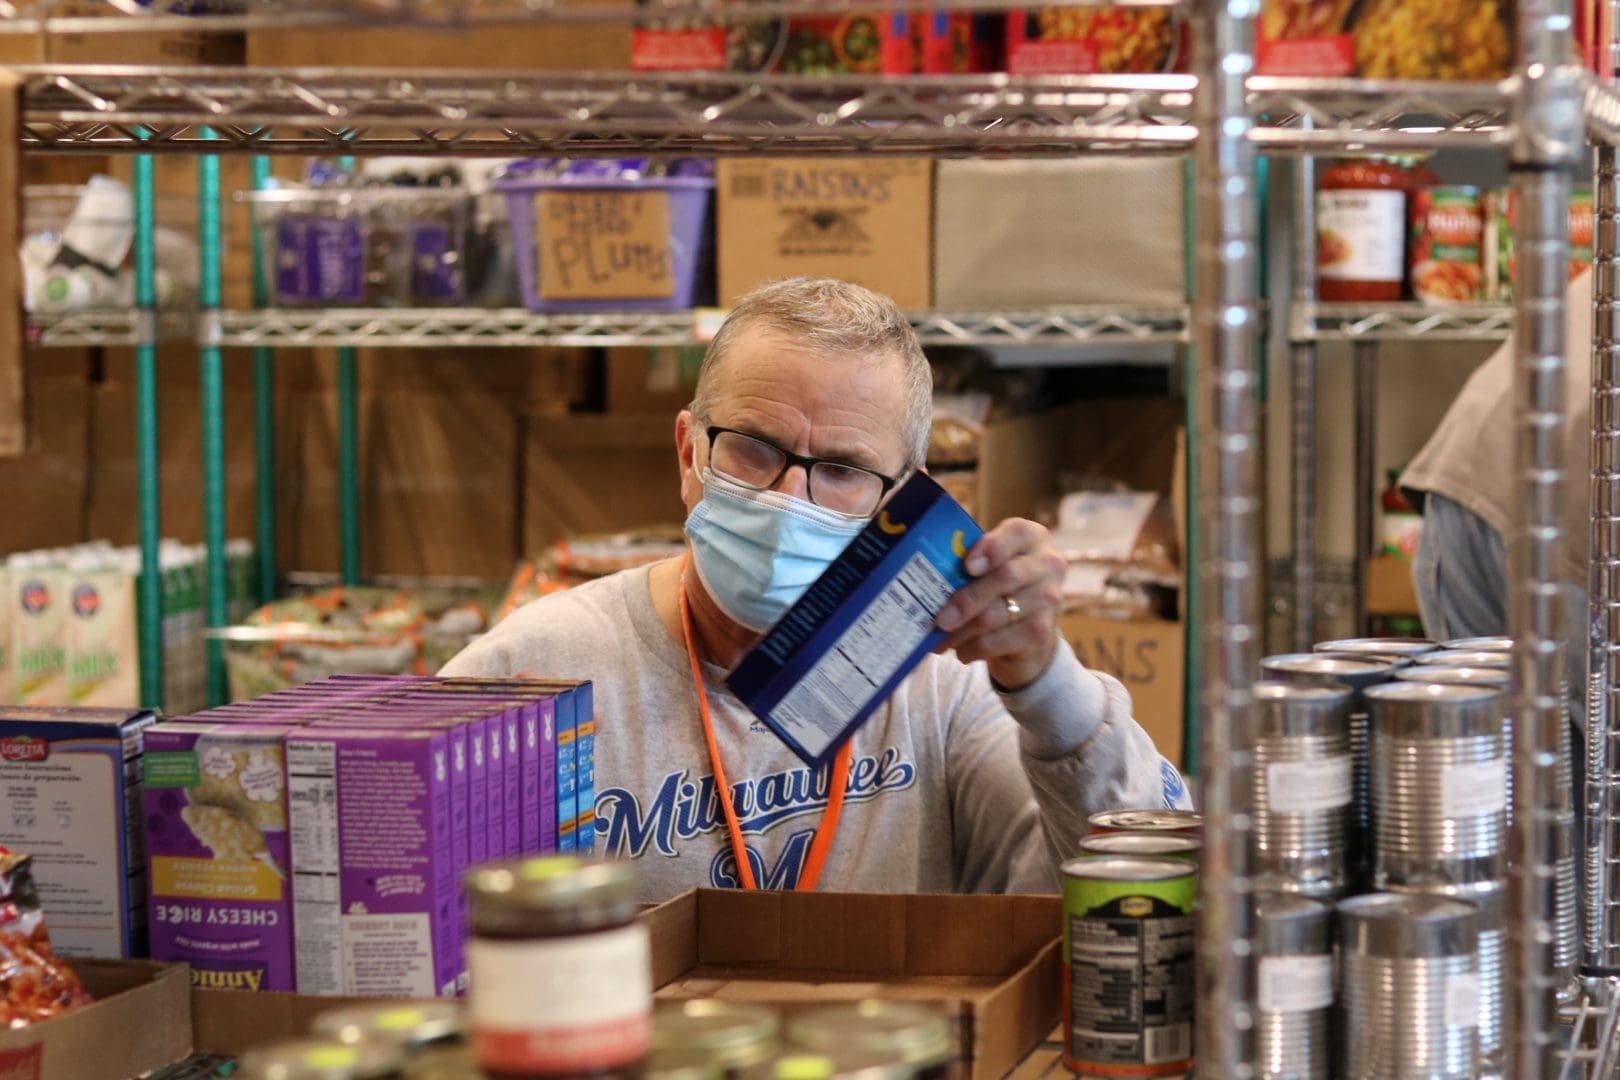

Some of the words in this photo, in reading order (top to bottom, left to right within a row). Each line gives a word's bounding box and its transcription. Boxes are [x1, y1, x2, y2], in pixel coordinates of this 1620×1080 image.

[772, 168, 892, 204] RAISINS
[594, 747, 916, 858] Milwauee
[155, 904, 202, 925] RICE
[207, 906, 279, 926] CHEESY
